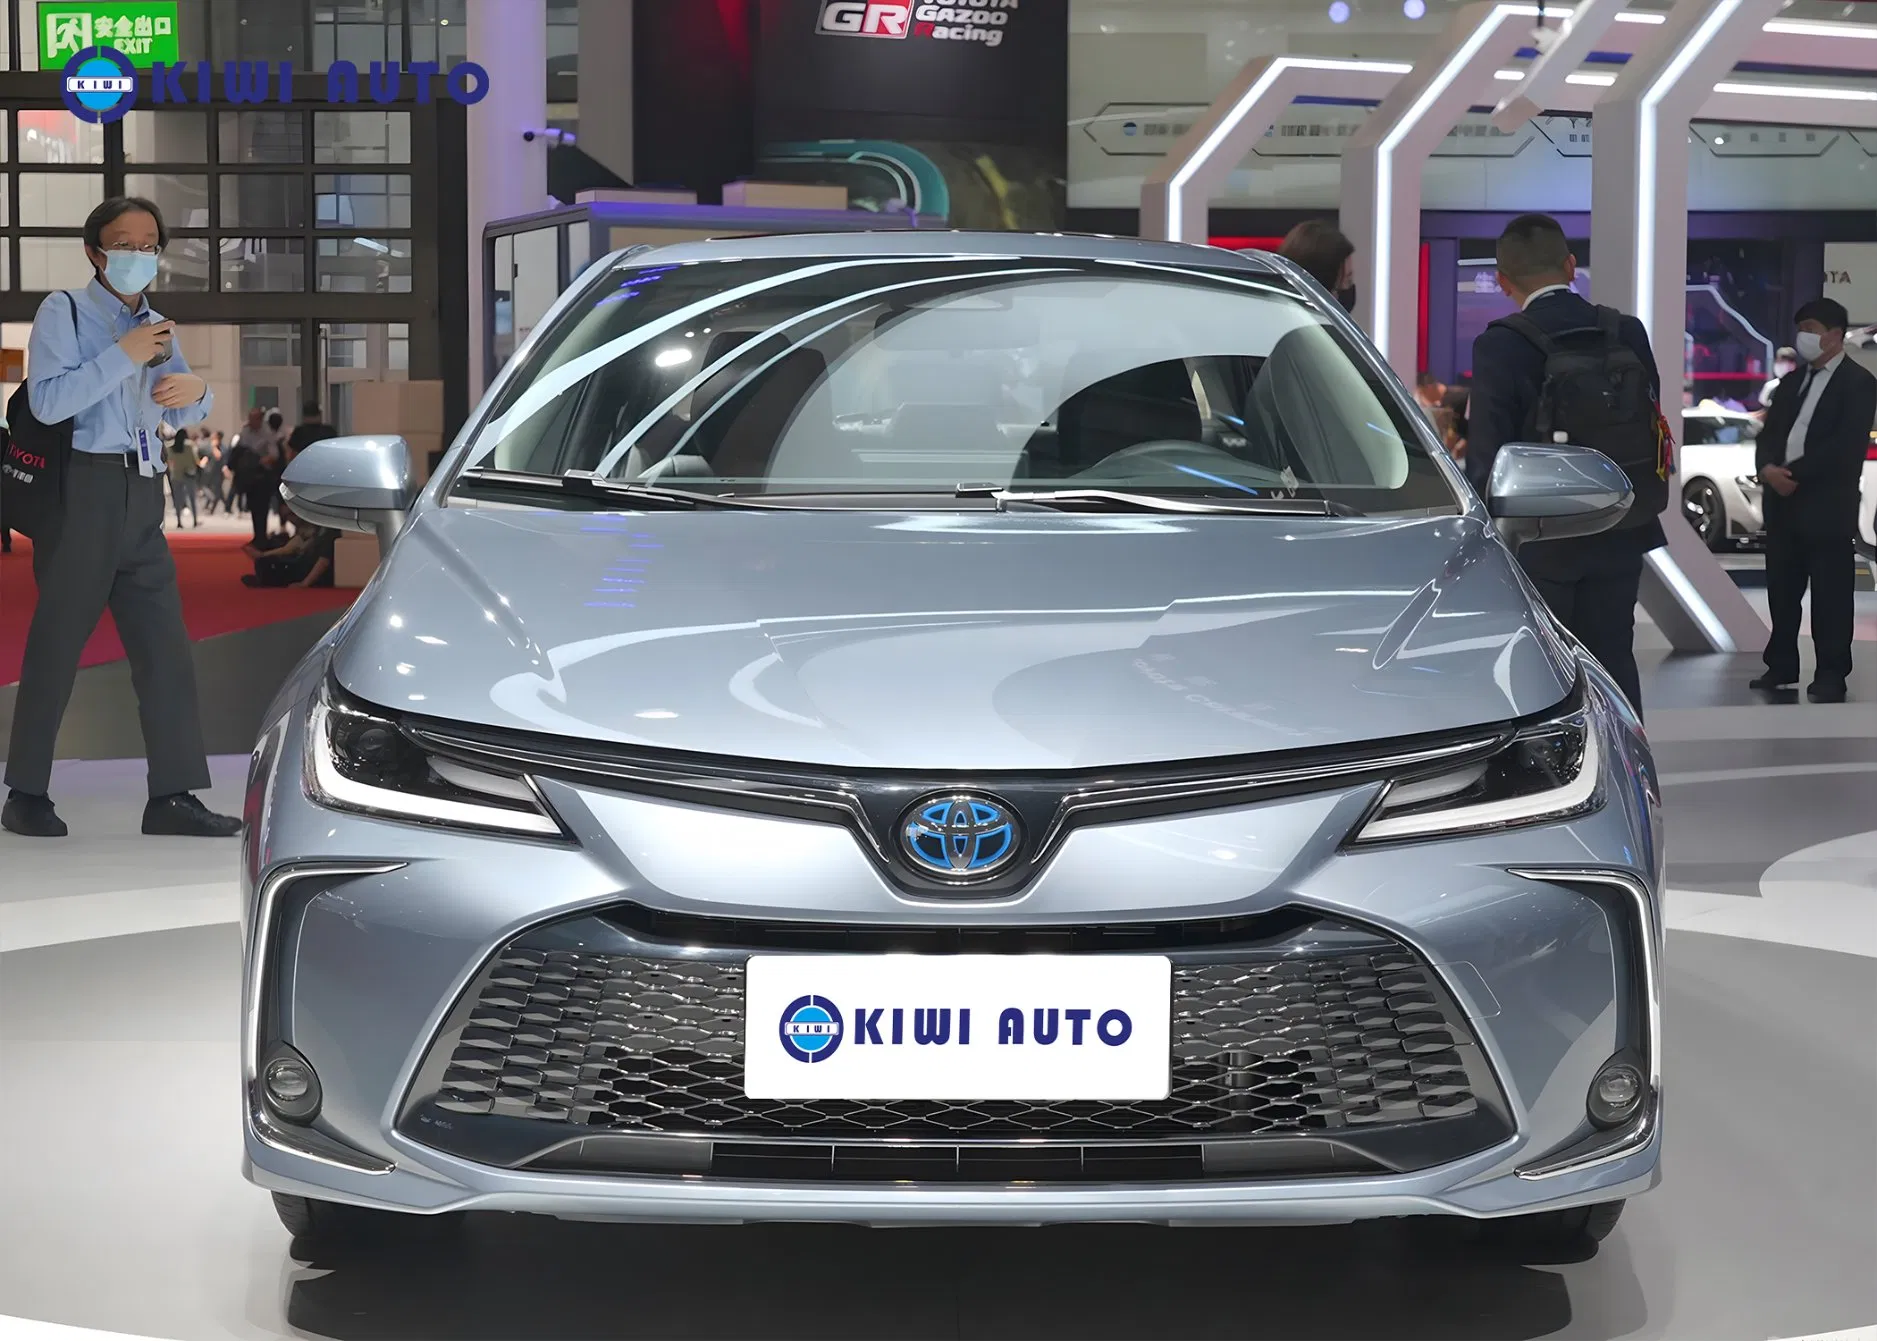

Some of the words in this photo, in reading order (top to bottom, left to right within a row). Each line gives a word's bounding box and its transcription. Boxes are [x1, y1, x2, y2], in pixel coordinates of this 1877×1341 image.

[822, 2, 908, 35] GR
[915, 4, 1008, 25] GAZOO
[94, 15, 171, 38] 安全出口
[914, 21, 1003, 46] Racing
[114, 37, 153, 54] EXIT
